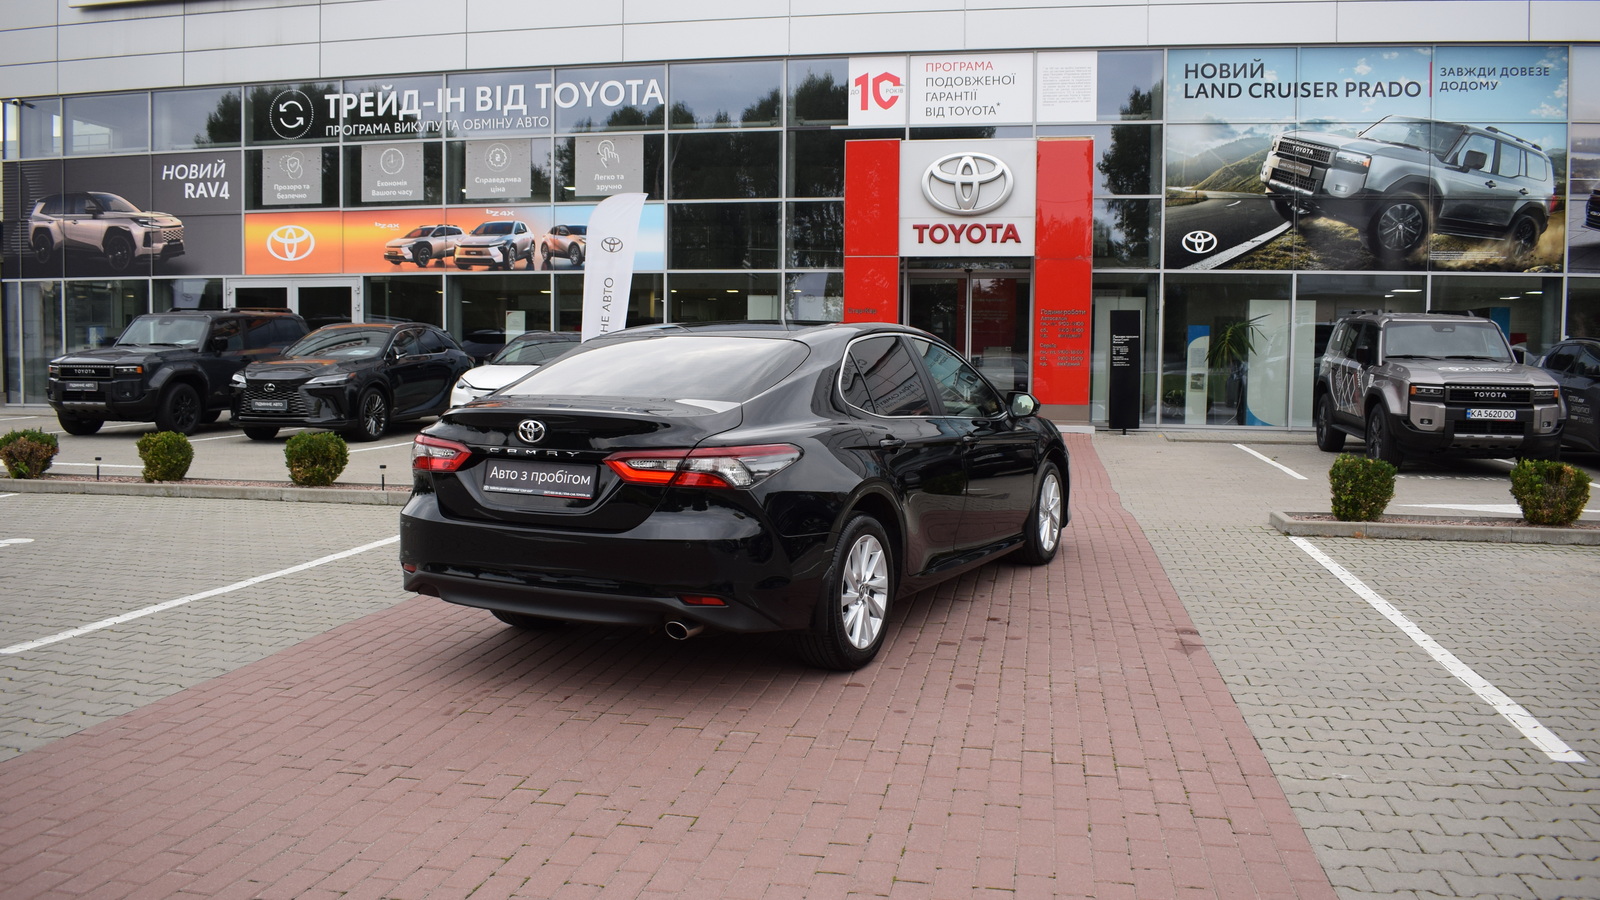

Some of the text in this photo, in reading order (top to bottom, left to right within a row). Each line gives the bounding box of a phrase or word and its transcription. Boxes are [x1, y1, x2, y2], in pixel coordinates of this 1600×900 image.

[925, 61, 994, 73] ПРОГРАМА
[1184, 58, 1265, 79] НОВИЙ
[1440, 67, 1550, 78] ЗАВЖДИ ДОВЕЗЕ
[925, 73, 1017, 88] ПОДОВЖЕНОЇ
[1439, 81, 1499, 92] ДОДОМУ
[925, 88, 978, 102] ГАРАНТІЇ
[1184, 81, 1421, 99] LAND CRUISER PRADO
[324, 79, 665, 121] ТРЕЙД-ІН ВІД TOYOTA
[925, 106, 945, 118] ВІД
[325, 115, 550, 137] ПРОГРАМА ВИКУПУ ТА ОБМІНУ АВТО
[1292, 145, 1314, 155] TOYOTA
[162, 159, 226, 181] НОВИЙ
[376, 179, 408, 187] Економія
[474, 176, 522, 184] Справедлива
[594, 173, 615, 181] Легко
[184, 181, 230, 200] RAV4
[273, 183, 302, 192] Прозоро
[371, 189, 414, 197] Вашого часу
[490, 185, 506, 194] ціна
[912, 223, 1022, 244] TOYOTA
[602, 277, 614, 312] АВТО
[1471, 410, 1483, 418] KA
[1484, 410, 1502, 418] 5620
[489, 447, 580, 457] CAMRY
[490, 466, 591, 486] Авто з пробігом
